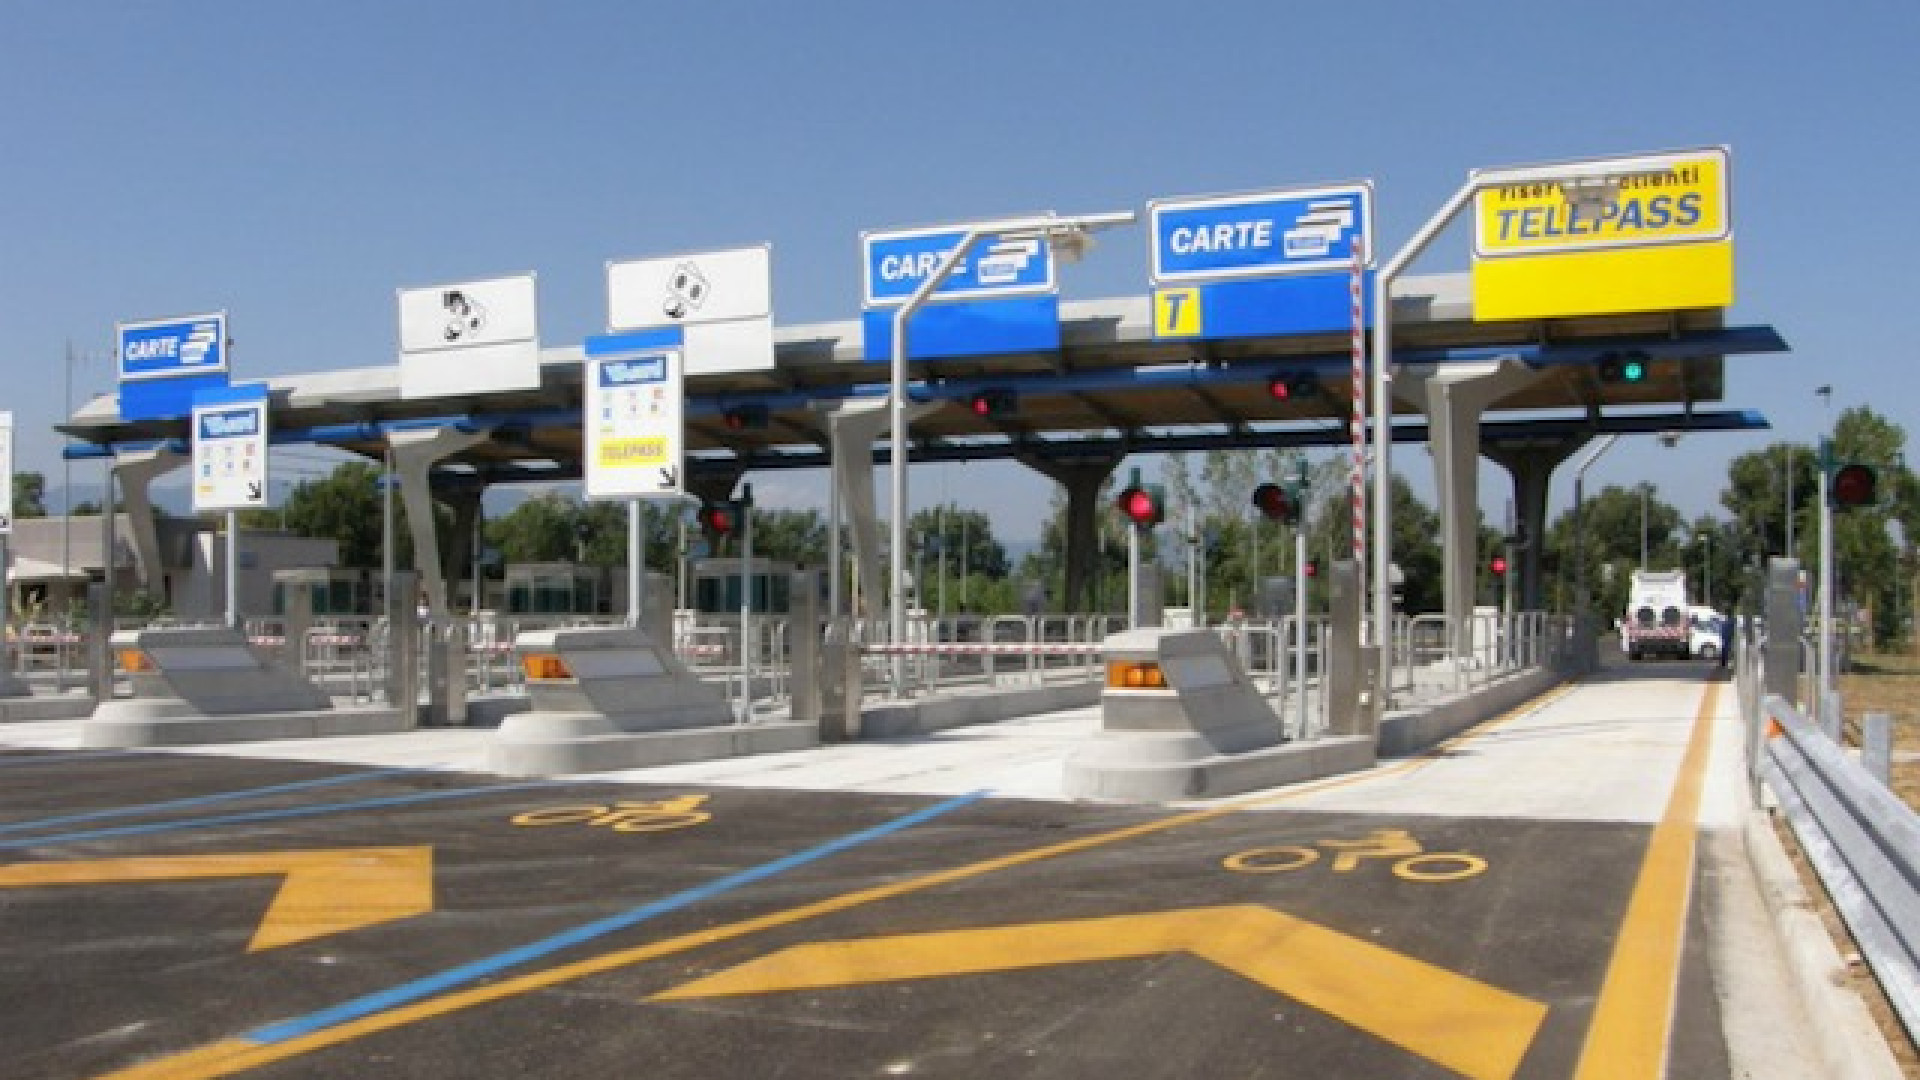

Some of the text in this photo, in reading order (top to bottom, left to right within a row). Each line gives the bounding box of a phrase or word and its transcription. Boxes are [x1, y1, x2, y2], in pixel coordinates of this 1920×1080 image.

[1496, 192, 1703, 241] TELEPASS
[1172, 218, 1273, 256] CARTE
[1164, 292, 1191, 331] T
[125, 335, 178, 361] CARTE
